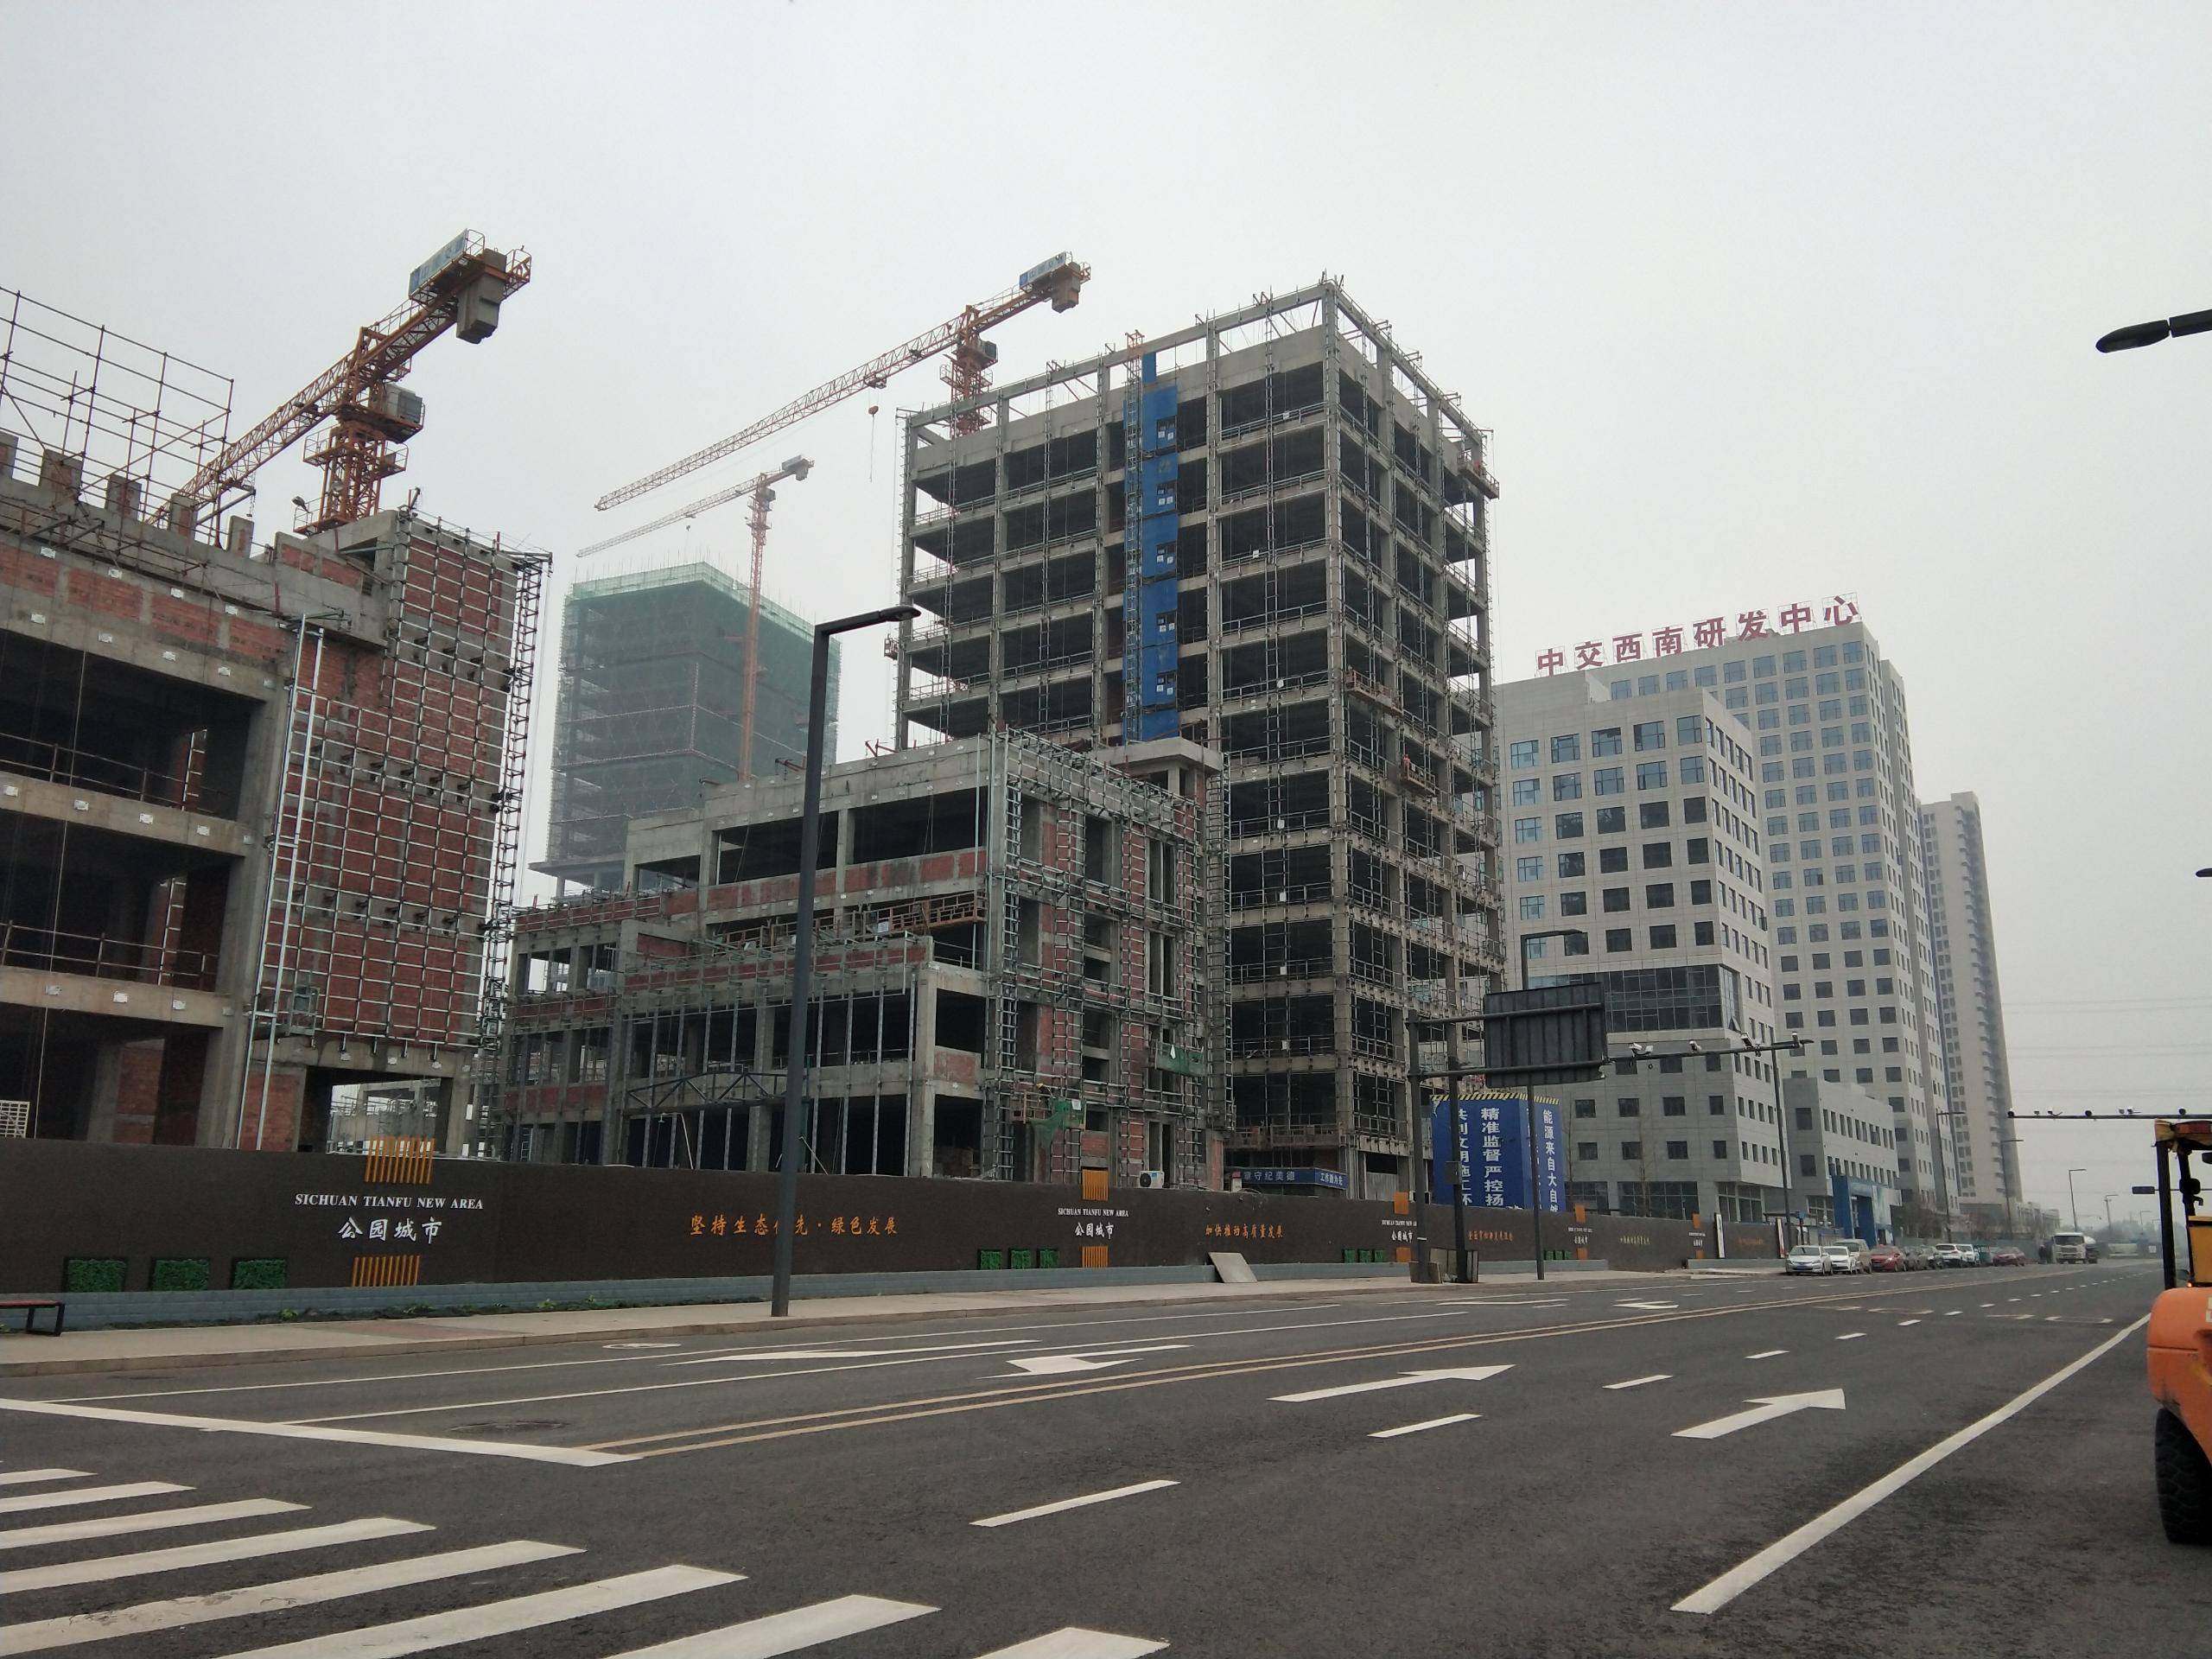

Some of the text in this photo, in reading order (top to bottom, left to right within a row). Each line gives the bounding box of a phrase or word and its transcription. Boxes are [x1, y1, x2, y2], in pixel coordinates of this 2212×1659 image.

[1537, 595, 1859, 677] 中交西南研发中心
[1480, 1107, 1504, 1207] 精准监督严控扬
[295, 1193, 484, 1210] SICHUAN TIANFU NEW AREA
[1058, 1207, 1082, 1216] SICHUAN
[1083, 1208, 1102, 1217] TIANFU
[338, 1217, 442, 1244] 公园城市
[690, 1213, 898, 1236] 坚持生态先·绿色发展
[1074, 1221, 1115, 1240] 公园城市
